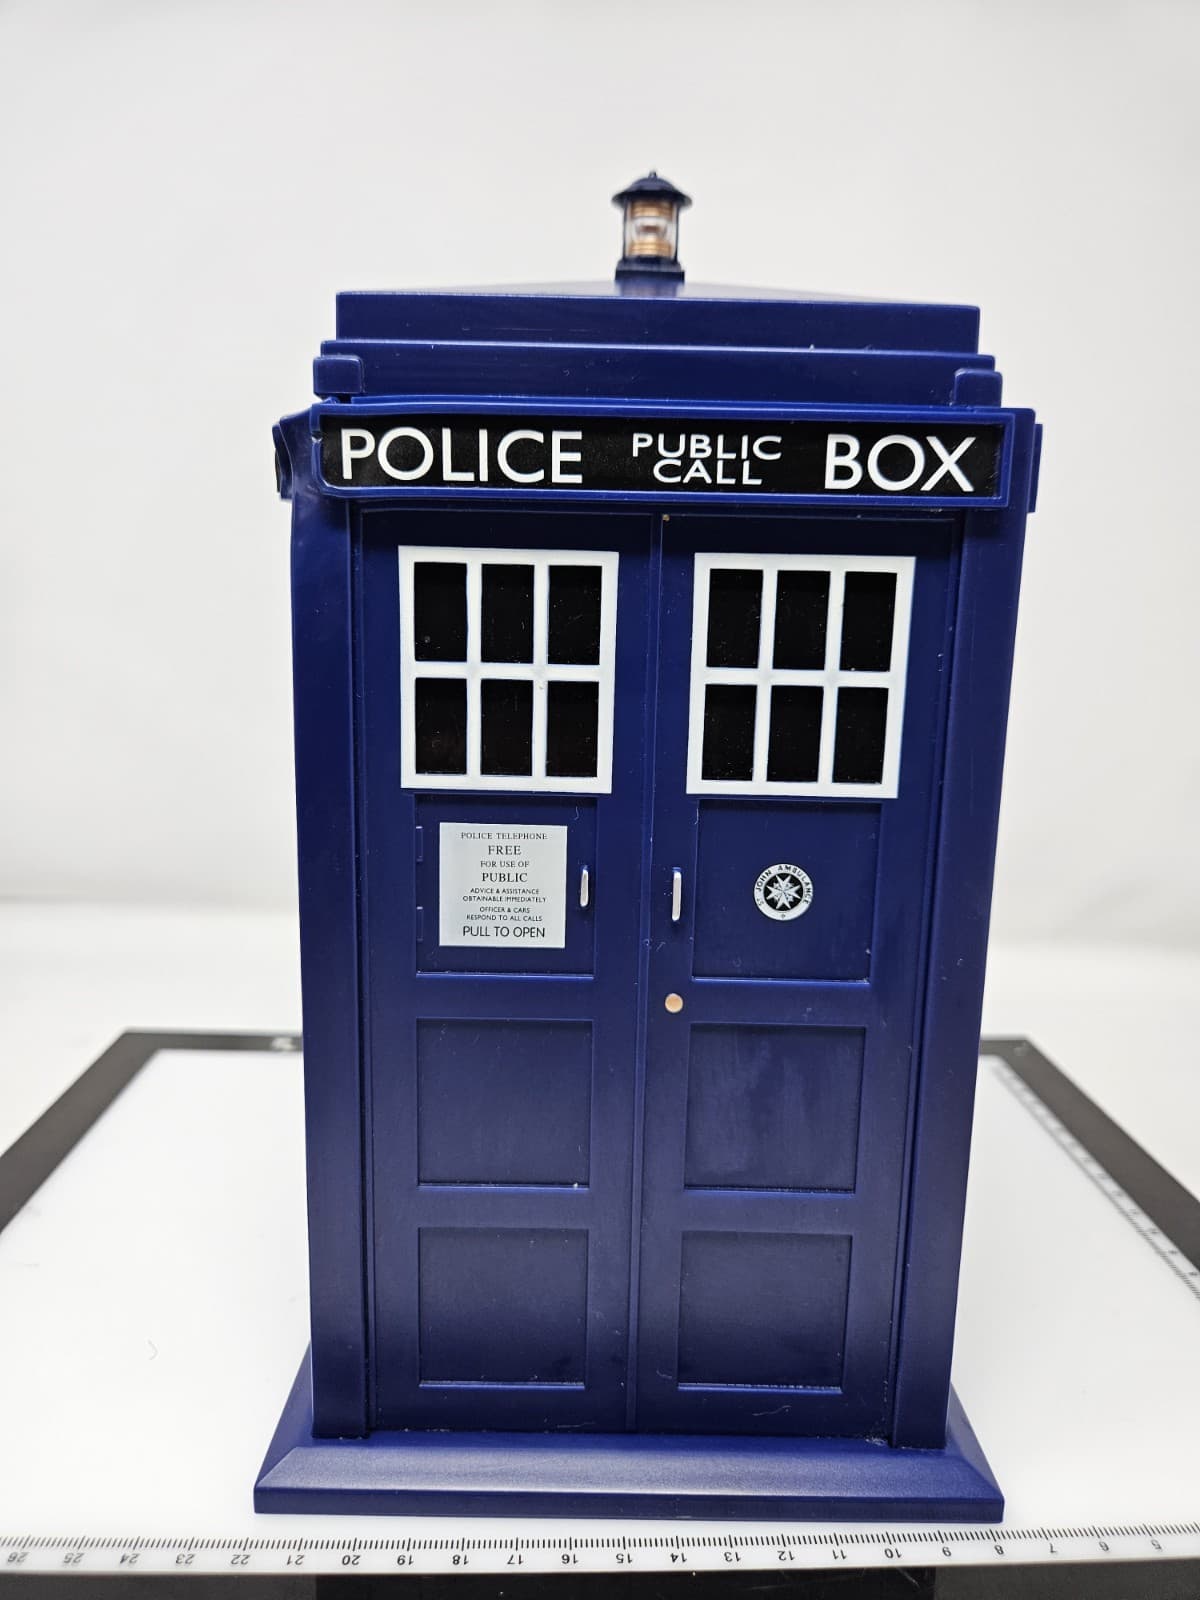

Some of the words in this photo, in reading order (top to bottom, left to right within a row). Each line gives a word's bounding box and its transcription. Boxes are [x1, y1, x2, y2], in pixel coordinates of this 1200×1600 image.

[633, 433, 782, 460] PUBLIC
[341, 428, 583, 483] POLICE
[824, 433, 976, 492] BOX
[652, 459, 763, 485] CALL
[488, 845, 521, 855] FREE
[482, 873, 528, 882] PUBLIC
[756, 870, 772, 891] JOHN
[778, 865, 811, 904] AMBULANCE
[463, 926, 490, 936] PULL
[495, 927, 509, 937] TO
[513, 927, 545, 938] OPEN
[941, 1546, 952, 1557] 9
[995, 1545, 1005, 1555] 8
[1048, 1544, 1058, 1554] 7
[1098, 1541, 1109, 1552] 6
[8, 1551, 28, 1563] 26
[64, 1551, 83, 1564] 25
[120, 1552, 139, 1565] 24
[175, 1552, 195, 1566] 23
[561, 1553, 578, 1565] 16
[616, 1552, 633, 1564] 15
[671, 1552, 687, 1563] 14
[724, 1550, 741, 1562] 13
[778, 1549, 795, 1561] 12
[832, 1548, 847, 1559] 11
[886, 1547, 902, 1559] 10
[231, 1553, 249, 1566] 22
[286, 1553, 303, 1566] 21
[341, 1553, 360, 1566] 20
[397, 1553, 414, 1566] 19
[451, 1553, 470, 1566] 18
[507, 1553, 524, 1566] 17
